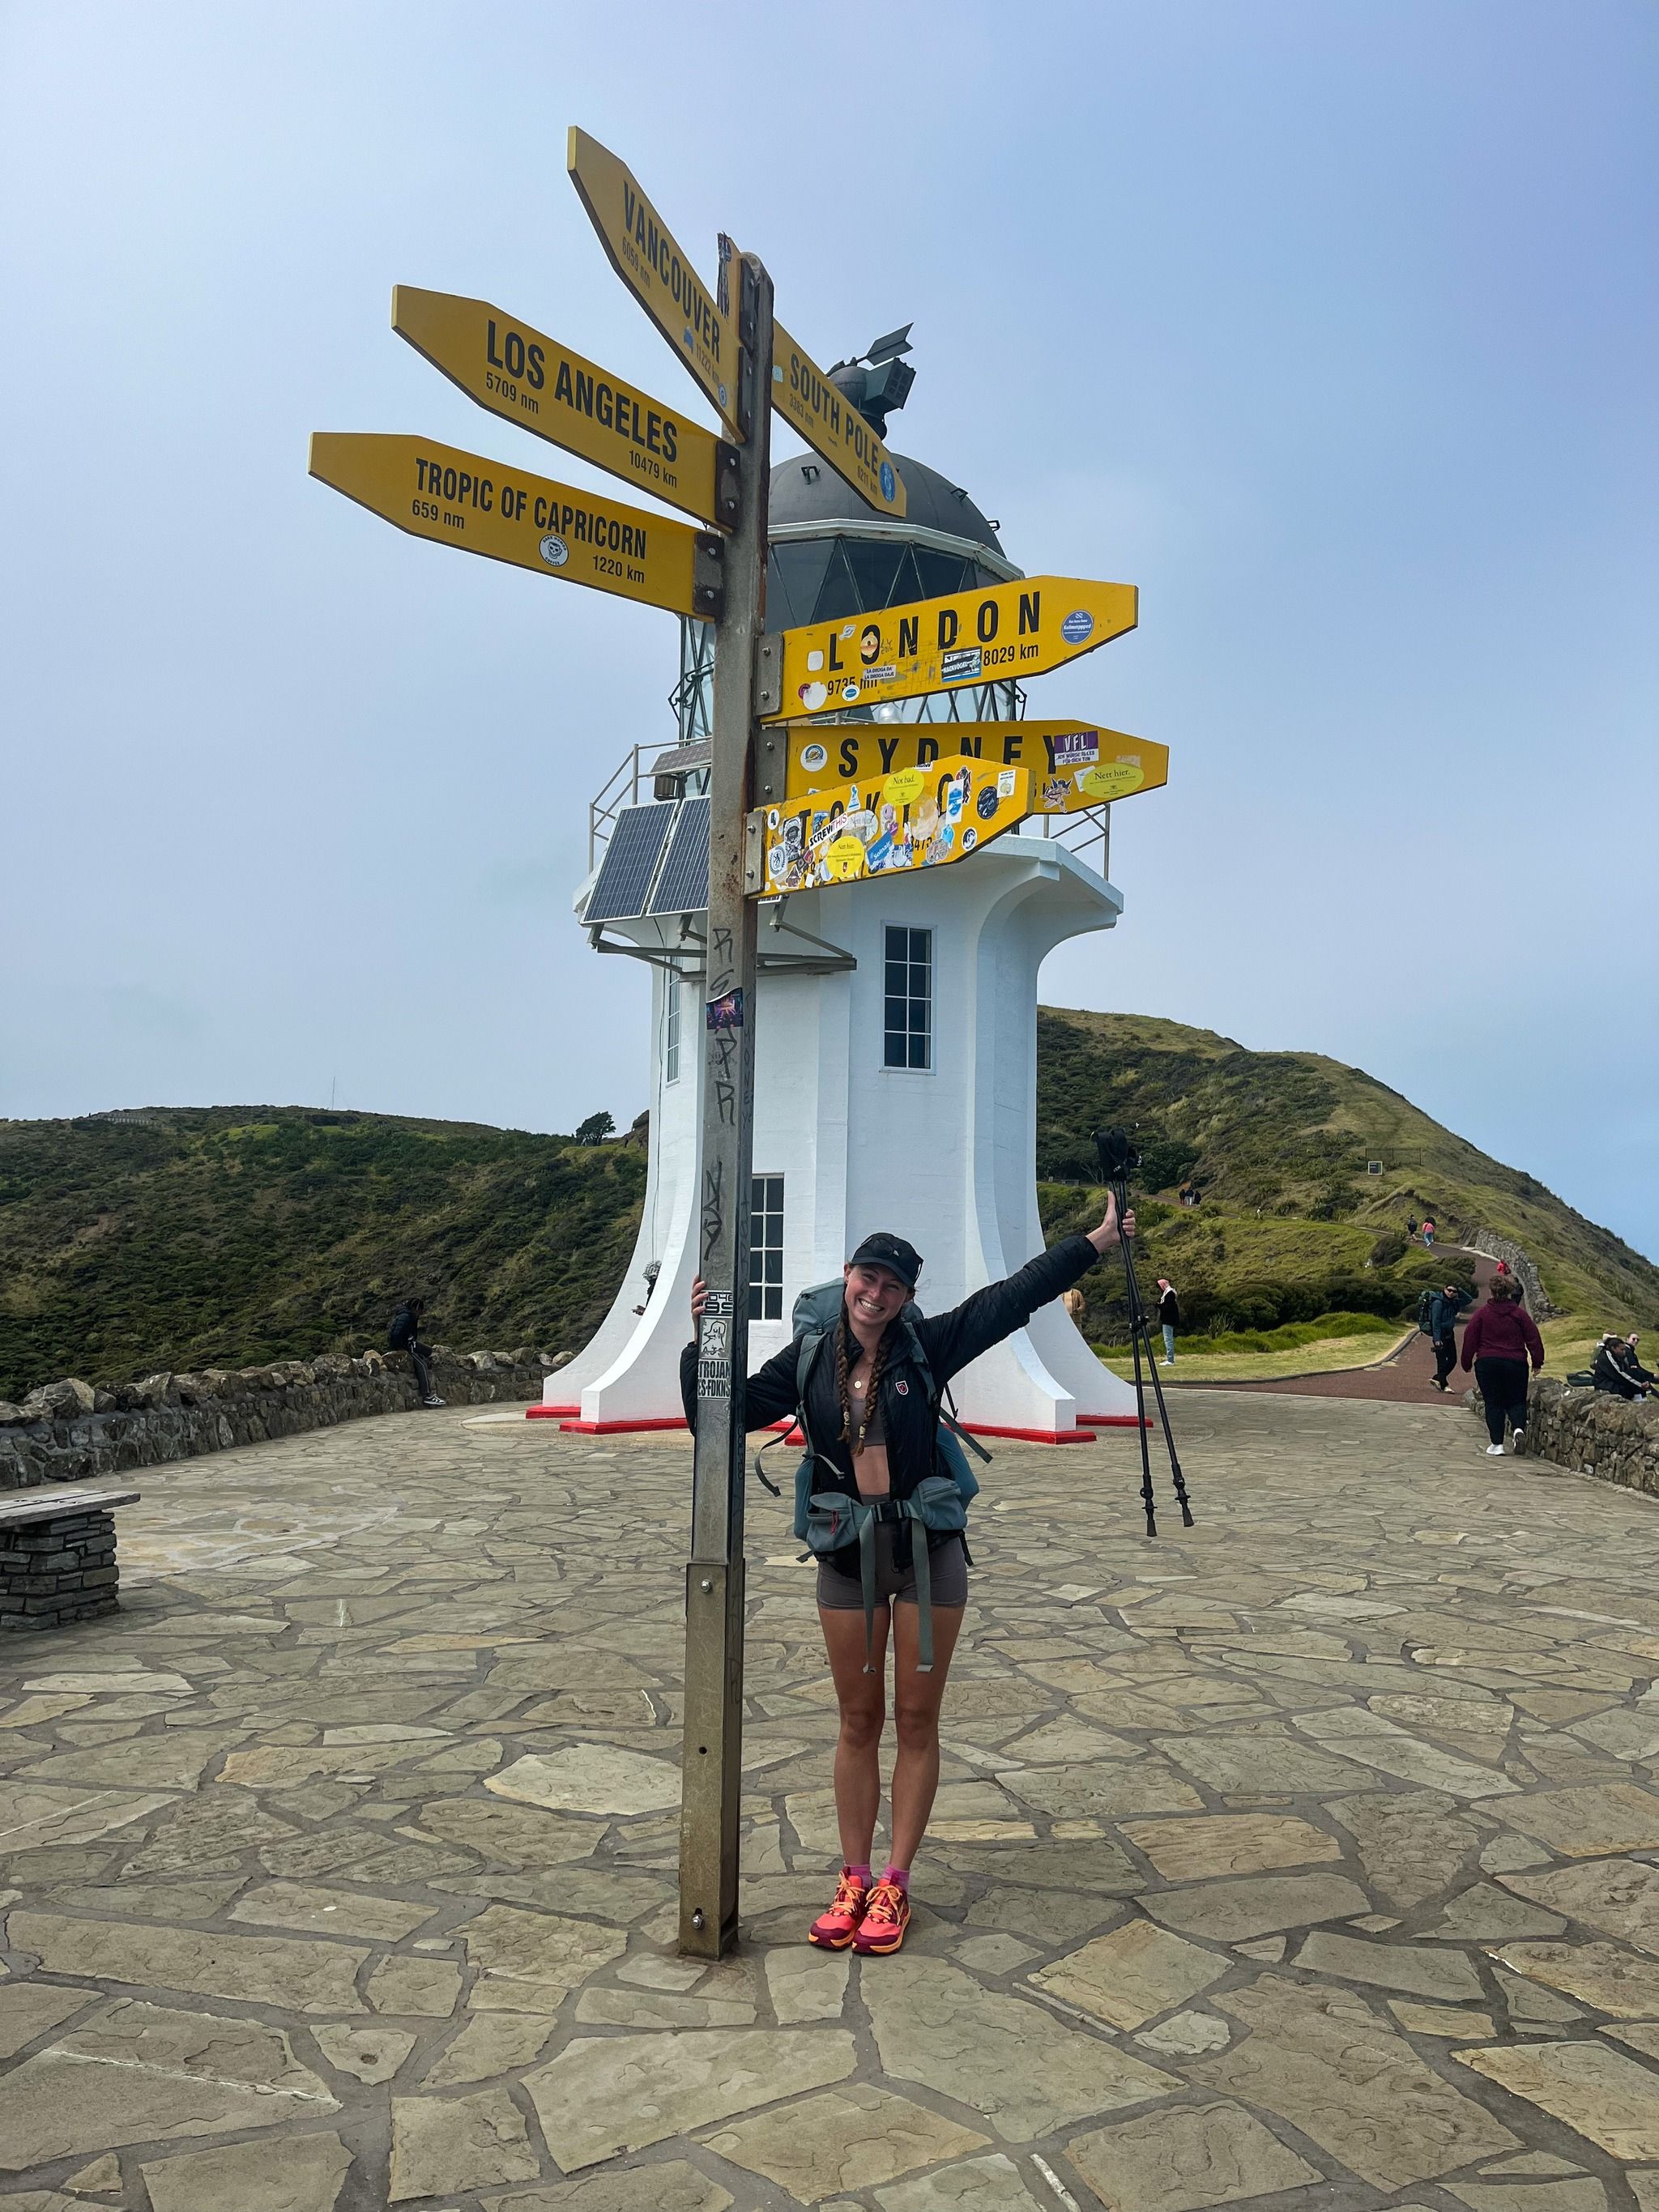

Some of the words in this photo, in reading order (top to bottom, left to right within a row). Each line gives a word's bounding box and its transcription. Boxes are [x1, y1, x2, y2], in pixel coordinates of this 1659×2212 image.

[623, 236, 638, 272] 6059
[640, 265, 650, 288] nm
[624, 180, 720, 364] VANCOUVER
[697, 343, 711, 377] 11222
[486, 372, 517, 403] 5709
[521, 392, 539, 415] nm
[487, 319, 545, 391] LOS
[554, 360, 678, 462] ANGELES
[790, 353, 840, 435] SOUTH
[845, 413, 879, 477] POLE
[804, 412, 814, 428] nm
[629, 448, 660, 480] 10479
[663, 465, 678, 488] km
[412, 499, 438, 522] 659
[443, 511, 465, 531] nm
[416, 458, 493, 512] TROPIC
[501, 485, 527, 522] OF
[534, 497, 646, 560] CAPRICORN
[592, 555, 623, 578] 1220
[626, 562, 645, 585] km
[829, 590, 1041, 671] LONDON
[983, 646, 1015, 667] 8029
[1020, 643, 1038, 660] km
[1094, 771, 1112, 780] Nett
[699, 1360, 731, 1379] TROJAN
